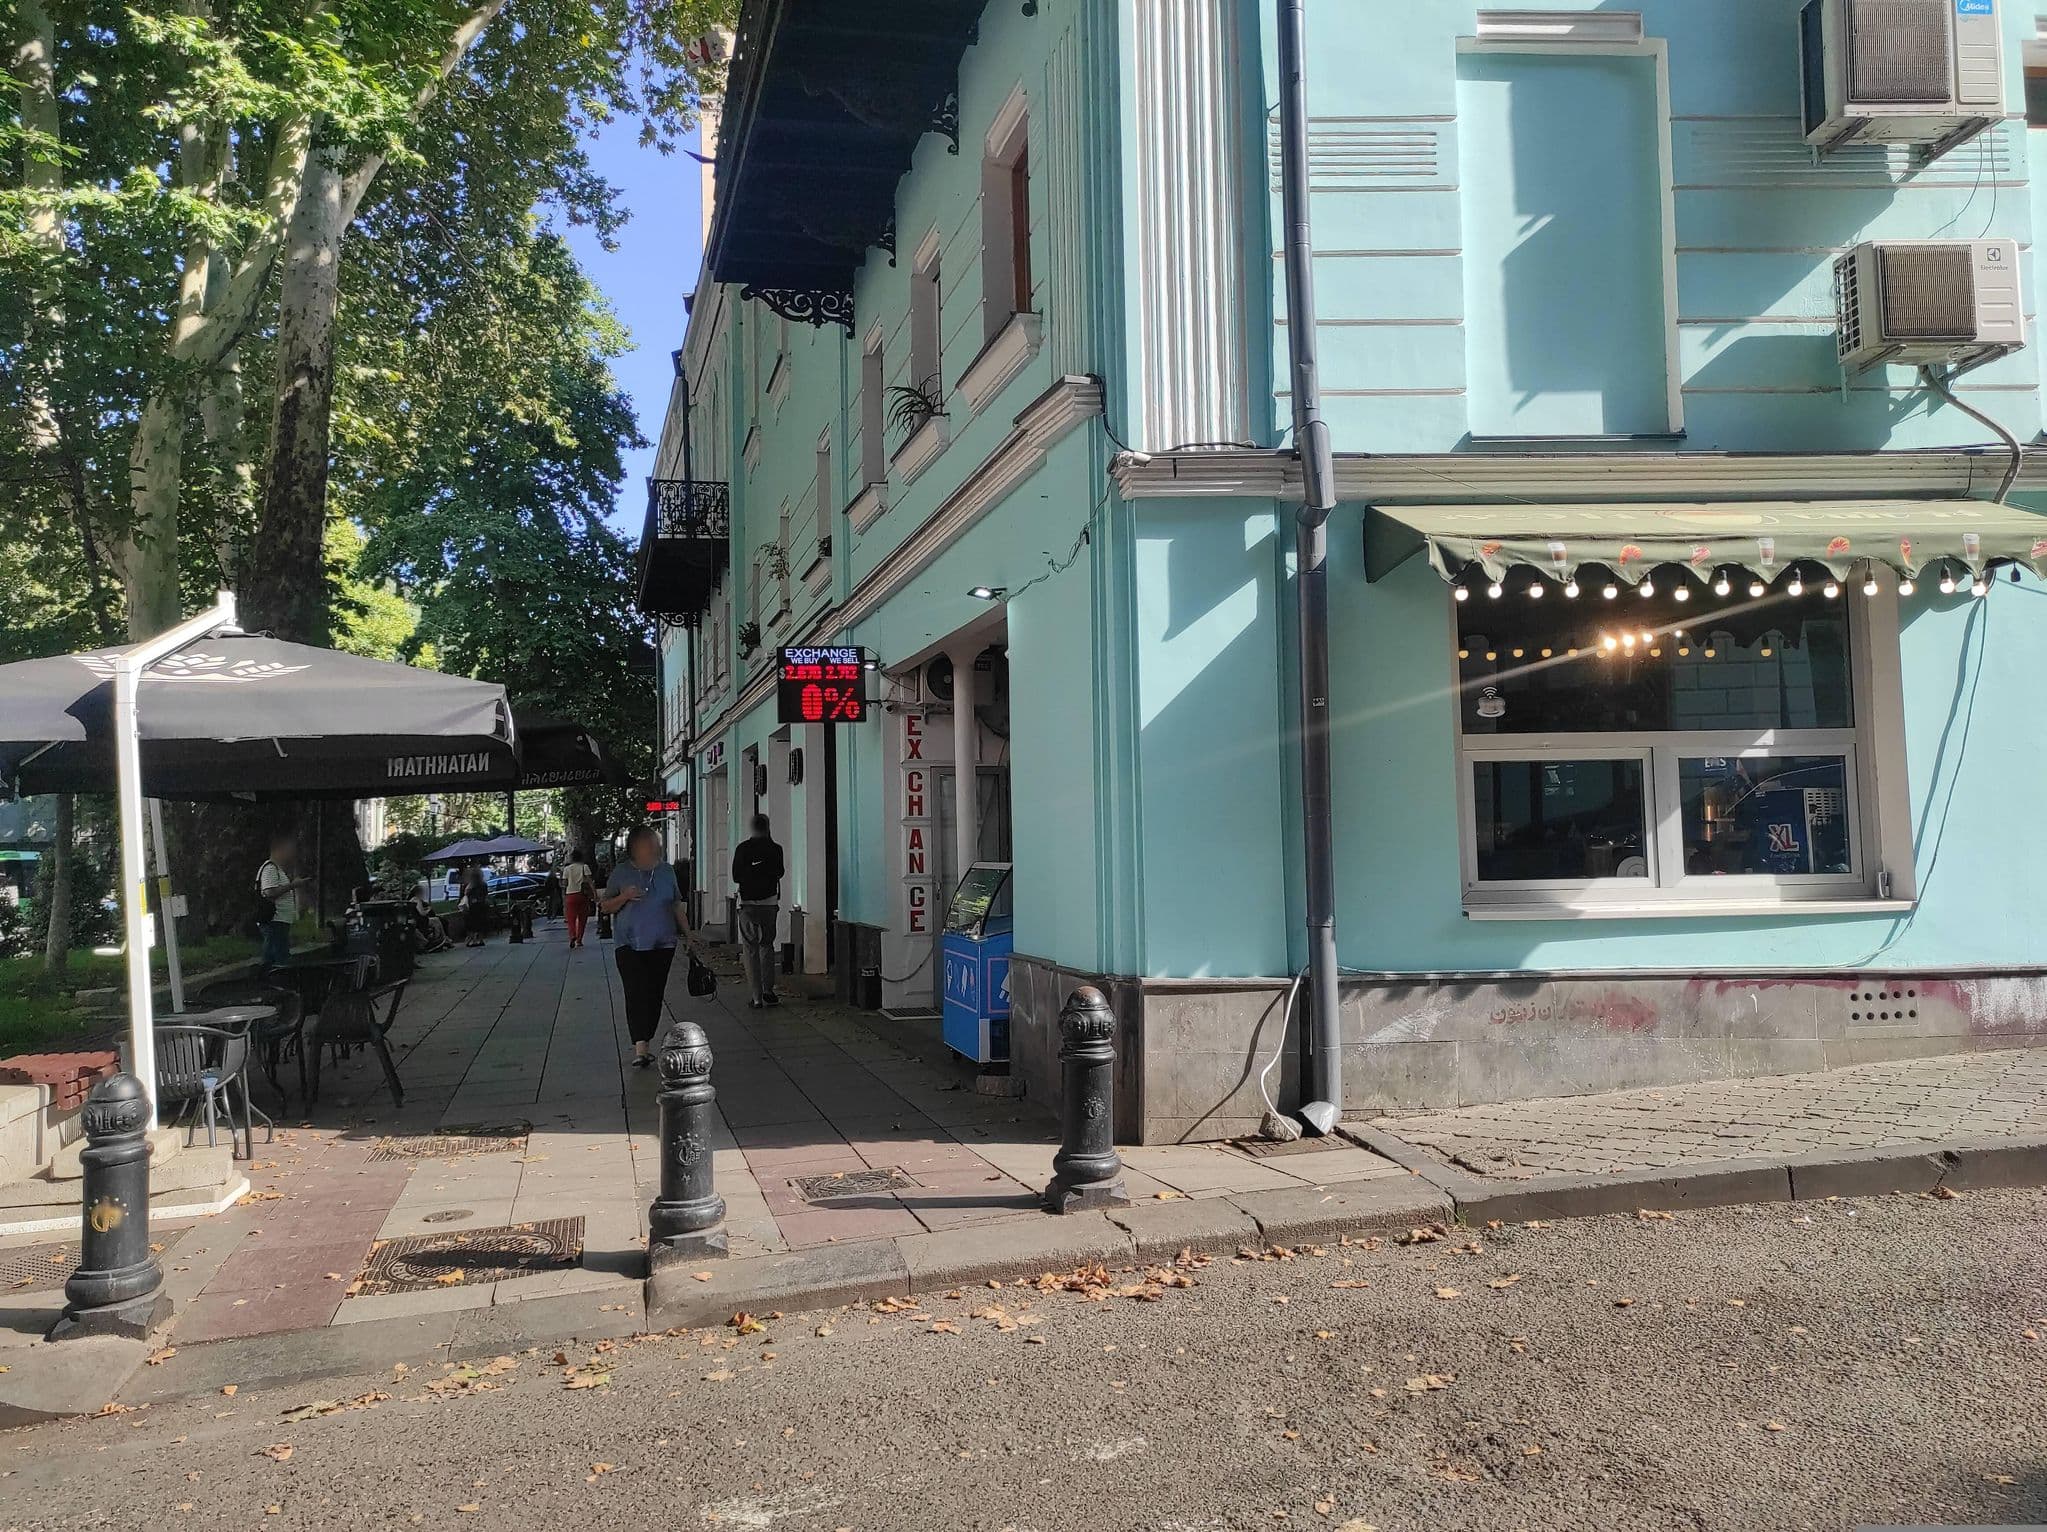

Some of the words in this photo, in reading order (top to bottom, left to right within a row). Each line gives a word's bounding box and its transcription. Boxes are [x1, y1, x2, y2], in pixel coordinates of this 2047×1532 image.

[785, 648, 857, 658] EXCHANGE
[906, 714, 926, 933] EXCHANGE
[1768, 823, 1800, 852] XL
